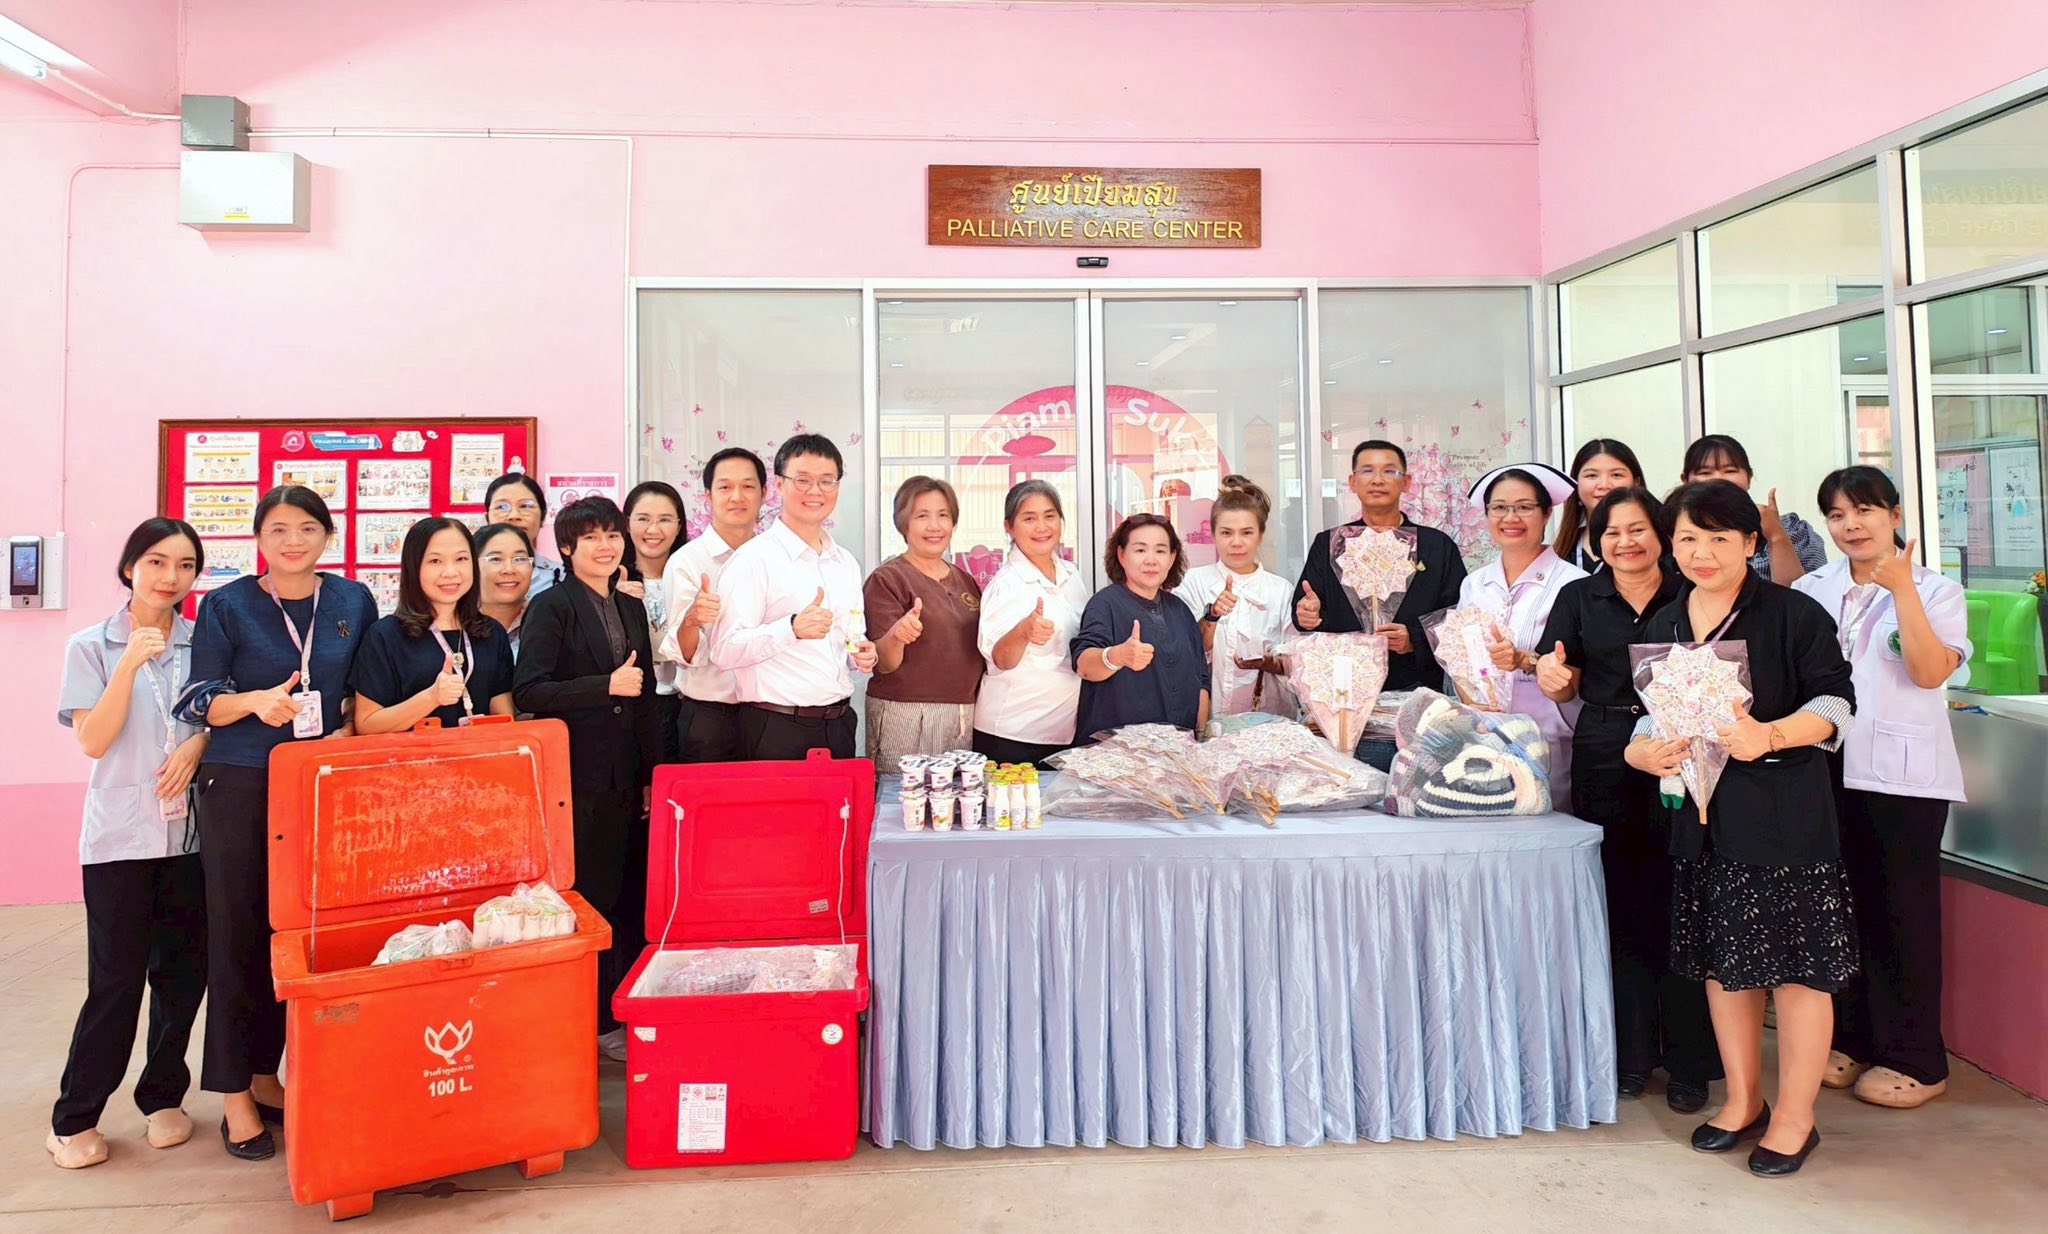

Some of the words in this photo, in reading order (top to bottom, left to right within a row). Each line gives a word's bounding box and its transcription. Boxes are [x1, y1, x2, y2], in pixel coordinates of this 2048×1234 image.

[947, 218, 1074, 238] PALLIATIVE
[1083, 220, 1145, 239] CARE
[1153, 220, 1244, 240] CENTER
[981, 398, 1072, 453] Piam
[1124, 398, 1192, 448] Suk
[428, 1078, 456, 1097] 100
[459, 1076, 473, 1092] L.
